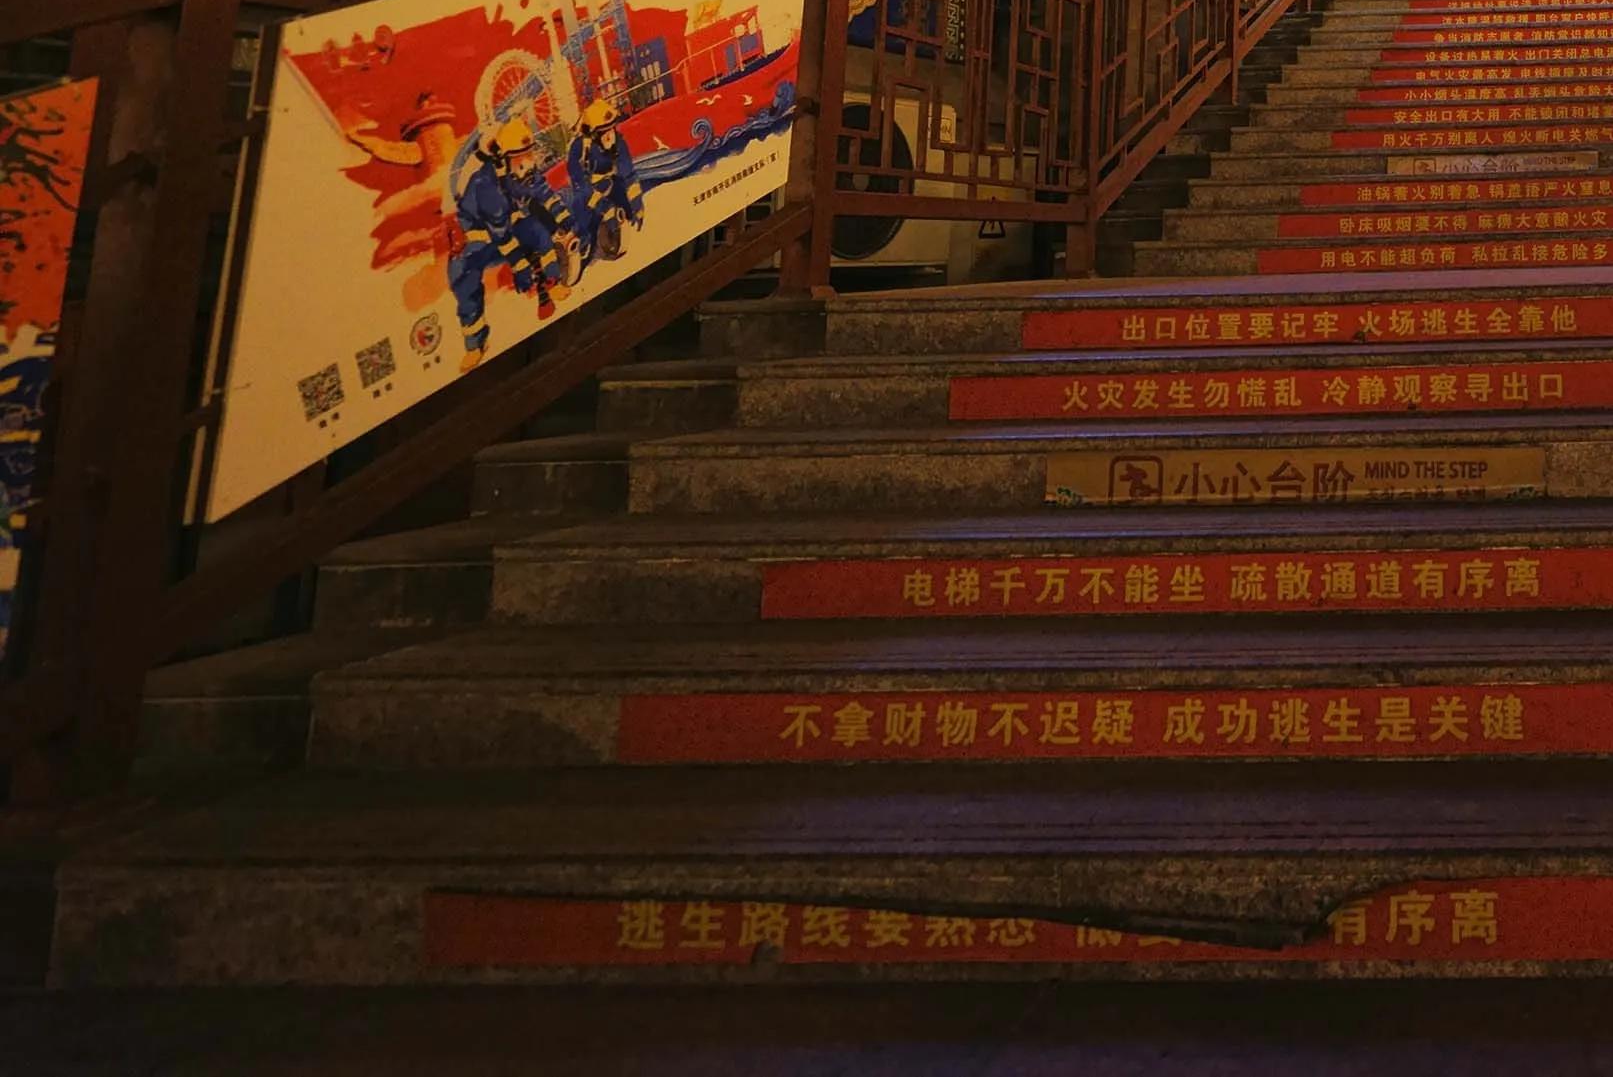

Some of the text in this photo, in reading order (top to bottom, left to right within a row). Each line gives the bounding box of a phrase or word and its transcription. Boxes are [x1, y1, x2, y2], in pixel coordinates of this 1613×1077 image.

[1383, 132, 1494, 147] 用火千万别离人
[1340, 216, 1468, 233] 卧床吸烟要不得
[1321, 243, 1608, 268] 用电不能超负荷 私拉乱接危险多
[1122, 306, 1577, 342] 出口位置要记牢 火场逃生全靠他
[1062, 371, 1563, 411] 火灾发生勿慌乱 冷静观察寻出口
[1364, 460, 1488, 479] MIND THE STEP
[903, 558, 1541, 606] 电梯千万不能坐 疏散通道有序离
[780, 694, 1525, 747] 不拿财物不迟疑 成功逃生是关键
